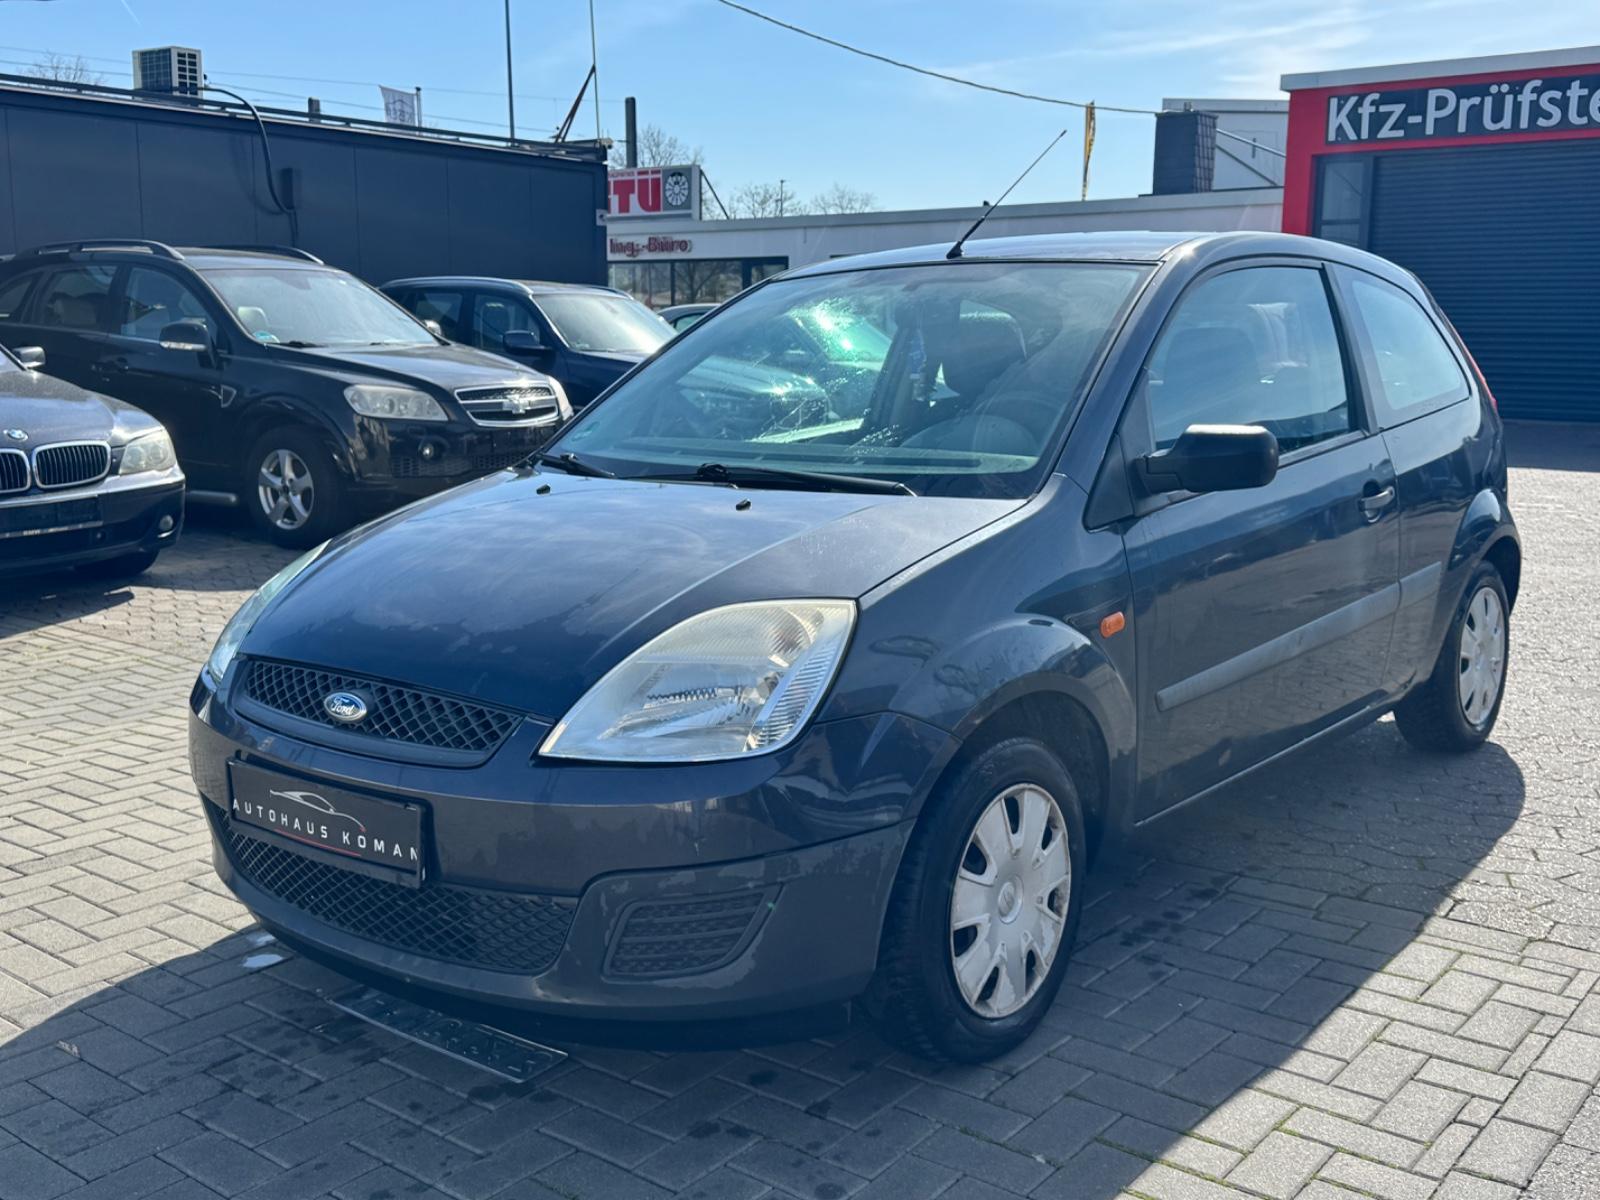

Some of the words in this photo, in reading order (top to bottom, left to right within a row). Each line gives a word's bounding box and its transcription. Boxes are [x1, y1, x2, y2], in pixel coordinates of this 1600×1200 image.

[608, 169, 661, 214] TÜ
[331, 696, 355, 715] Ford
[232, 798, 328, 839] AUTOHAUS
[342, 831, 418, 861] KOMAN
